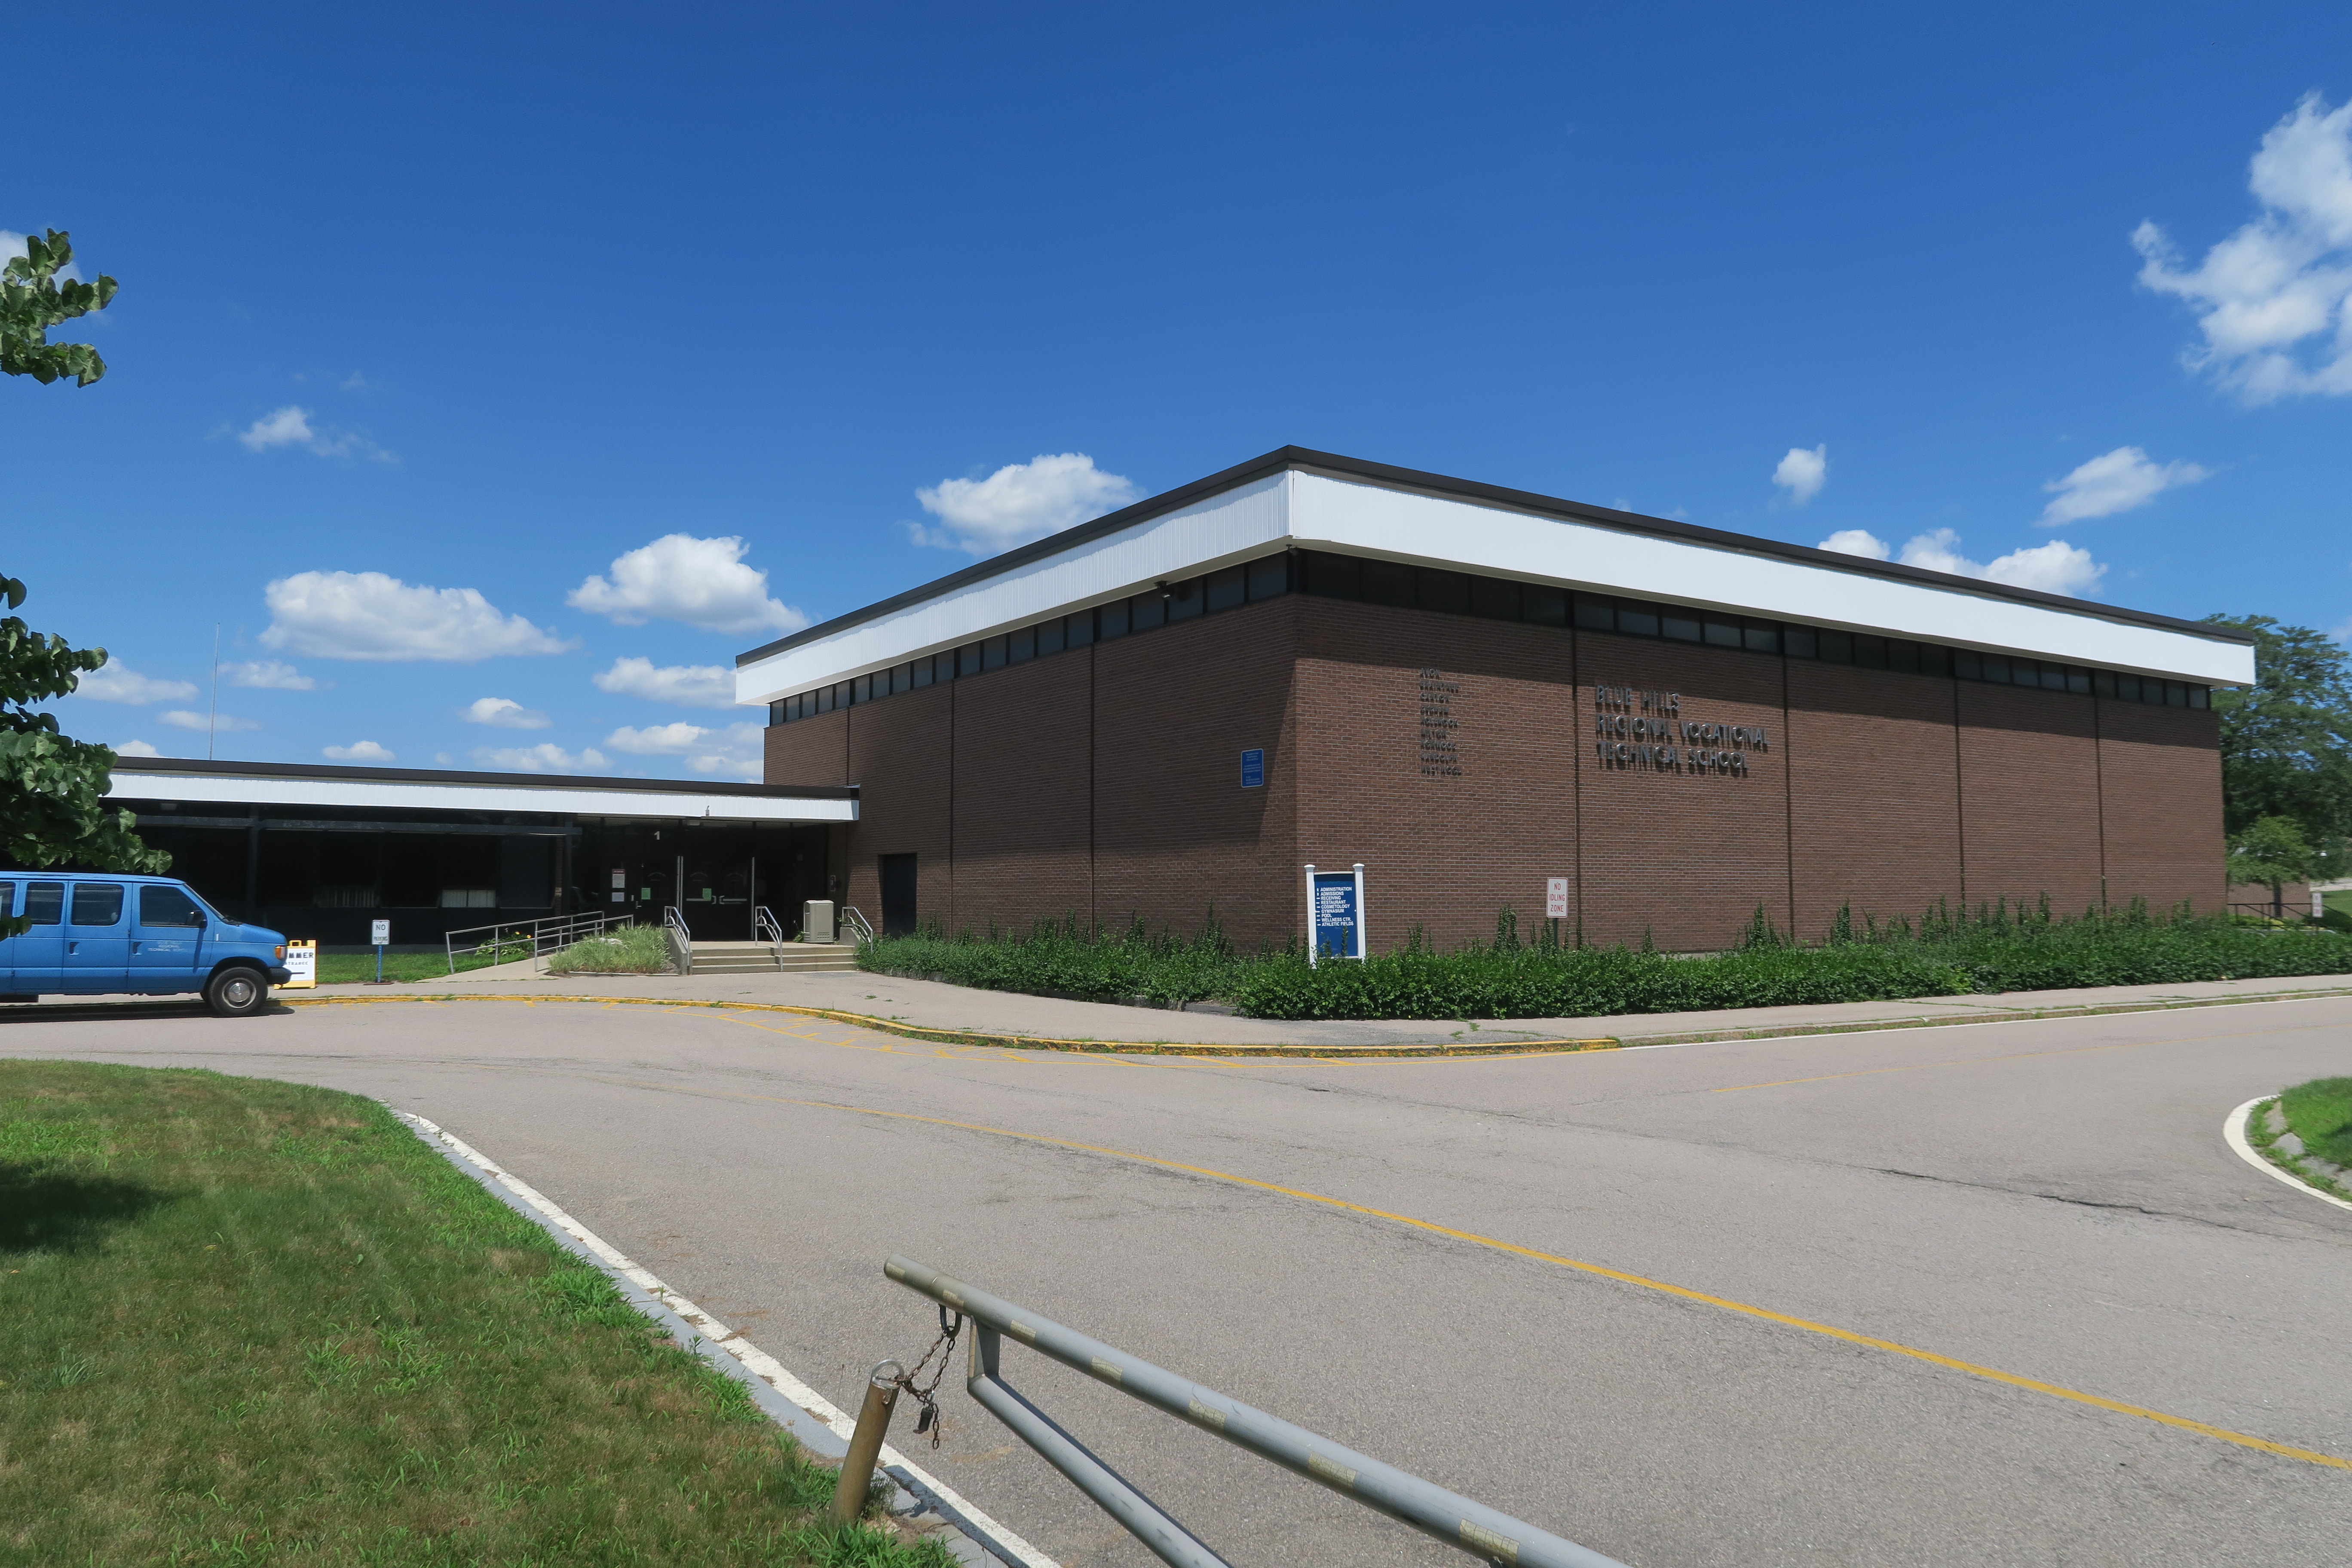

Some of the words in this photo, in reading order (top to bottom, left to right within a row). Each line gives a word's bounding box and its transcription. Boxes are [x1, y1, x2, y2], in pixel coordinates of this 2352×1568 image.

[1597, 685, 1632, 706] BLUE
[1642, 689, 1680, 709] HILLS
[1597, 713, 1674, 736] REGIONAL
[1679, 721, 1770, 744] VOCATIONAL
[1597, 741, 1683, 763] TECHNICAL
[1688, 748, 1749, 769] SCHOOL
[654, 831, 660, 840] 1
